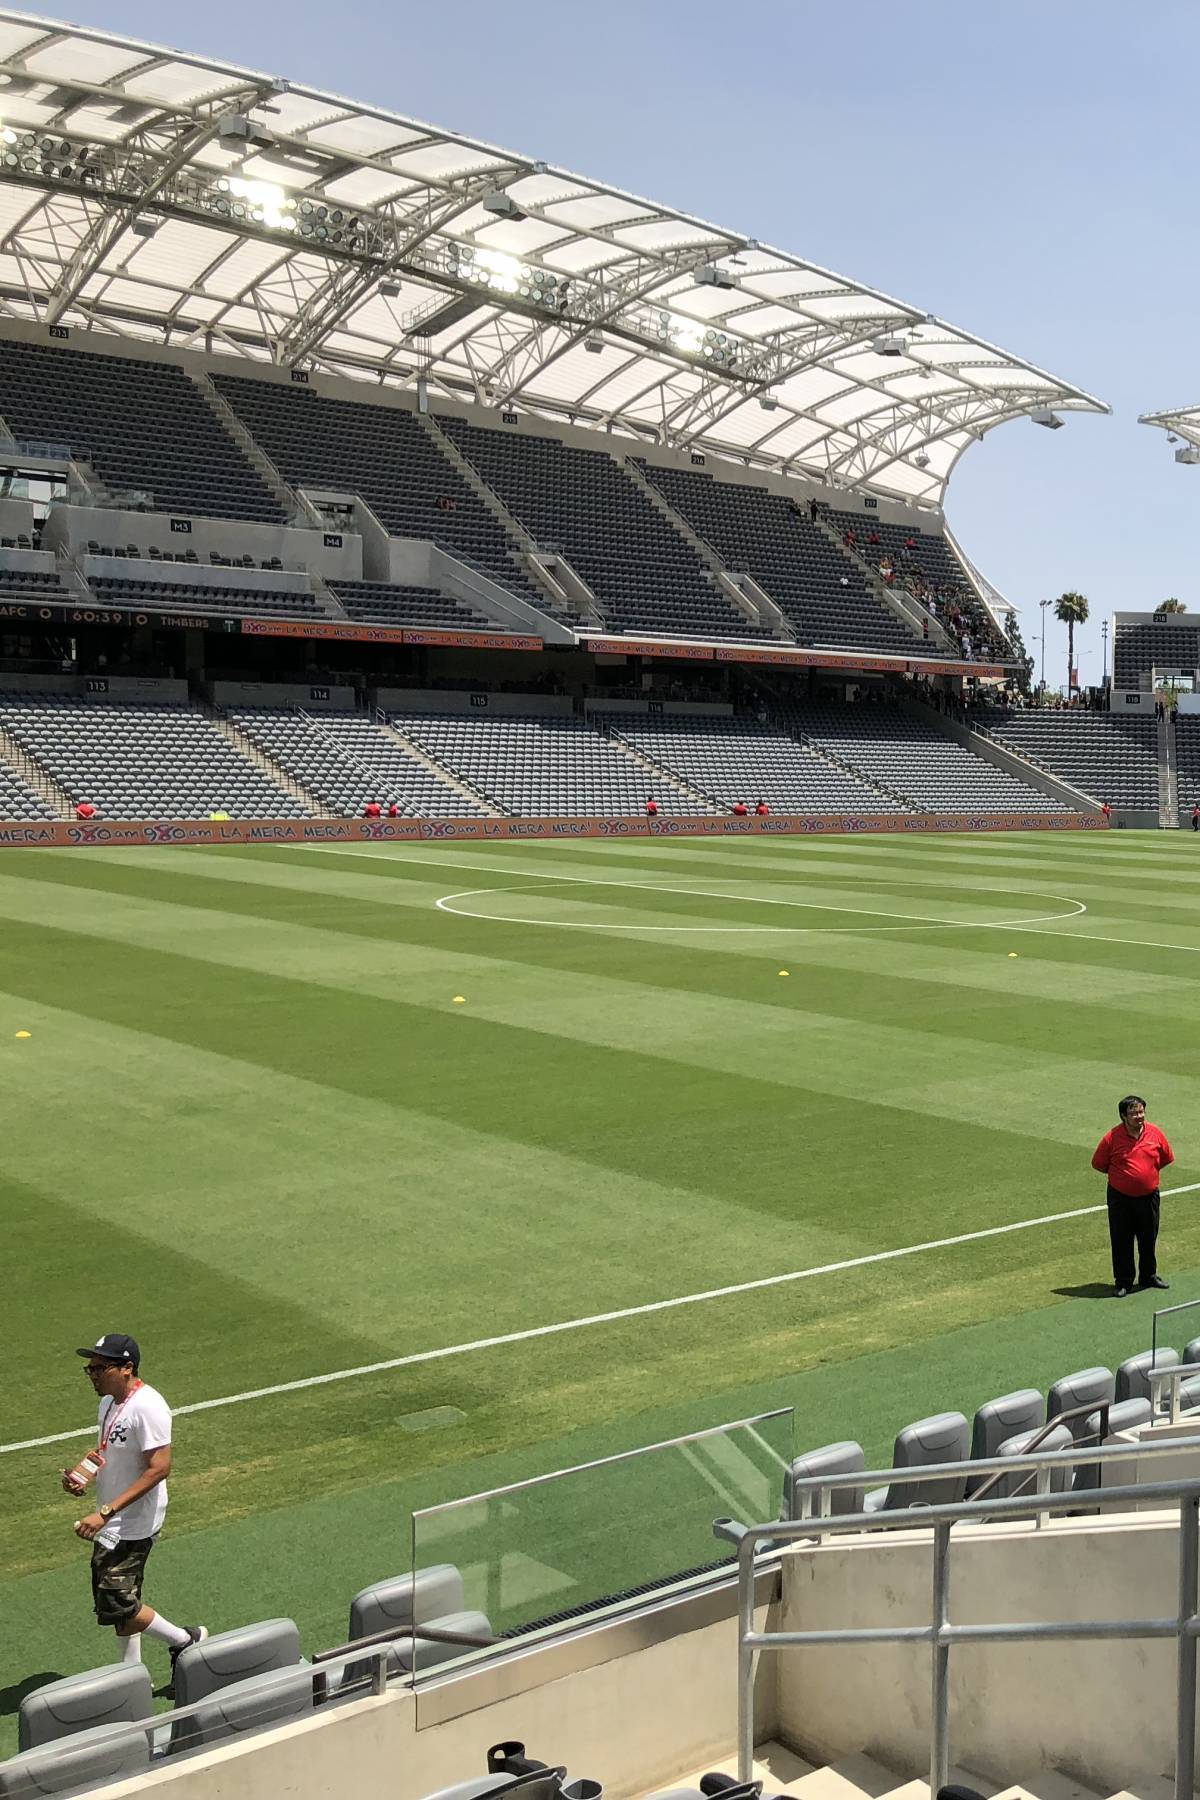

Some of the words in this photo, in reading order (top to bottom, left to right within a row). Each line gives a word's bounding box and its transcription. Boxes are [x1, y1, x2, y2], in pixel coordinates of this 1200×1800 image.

[50, 326, 68, 338] 213
[173, 521, 189, 532] M3
[326, 536, 341, 546] M4
[72, 610, 122, 623] 60:39
[160, 616, 209, 628] TIMBERS
[88, 681, 106, 691] 113
[312, 689, 328, 699] 114
[472, 696, 486, 706] 115
[220, 826, 242, 838] LA
[250, 826, 297, 838] MERA
[304, 824, 352, 838] MERA!
[484, 824, 501, 835] LA
[508, 824, 545, 834] MERA
[552, 822, 592, 834] MERA!
[702, 822, 718, 832] LA
[723, 822, 753, 832] MERA
